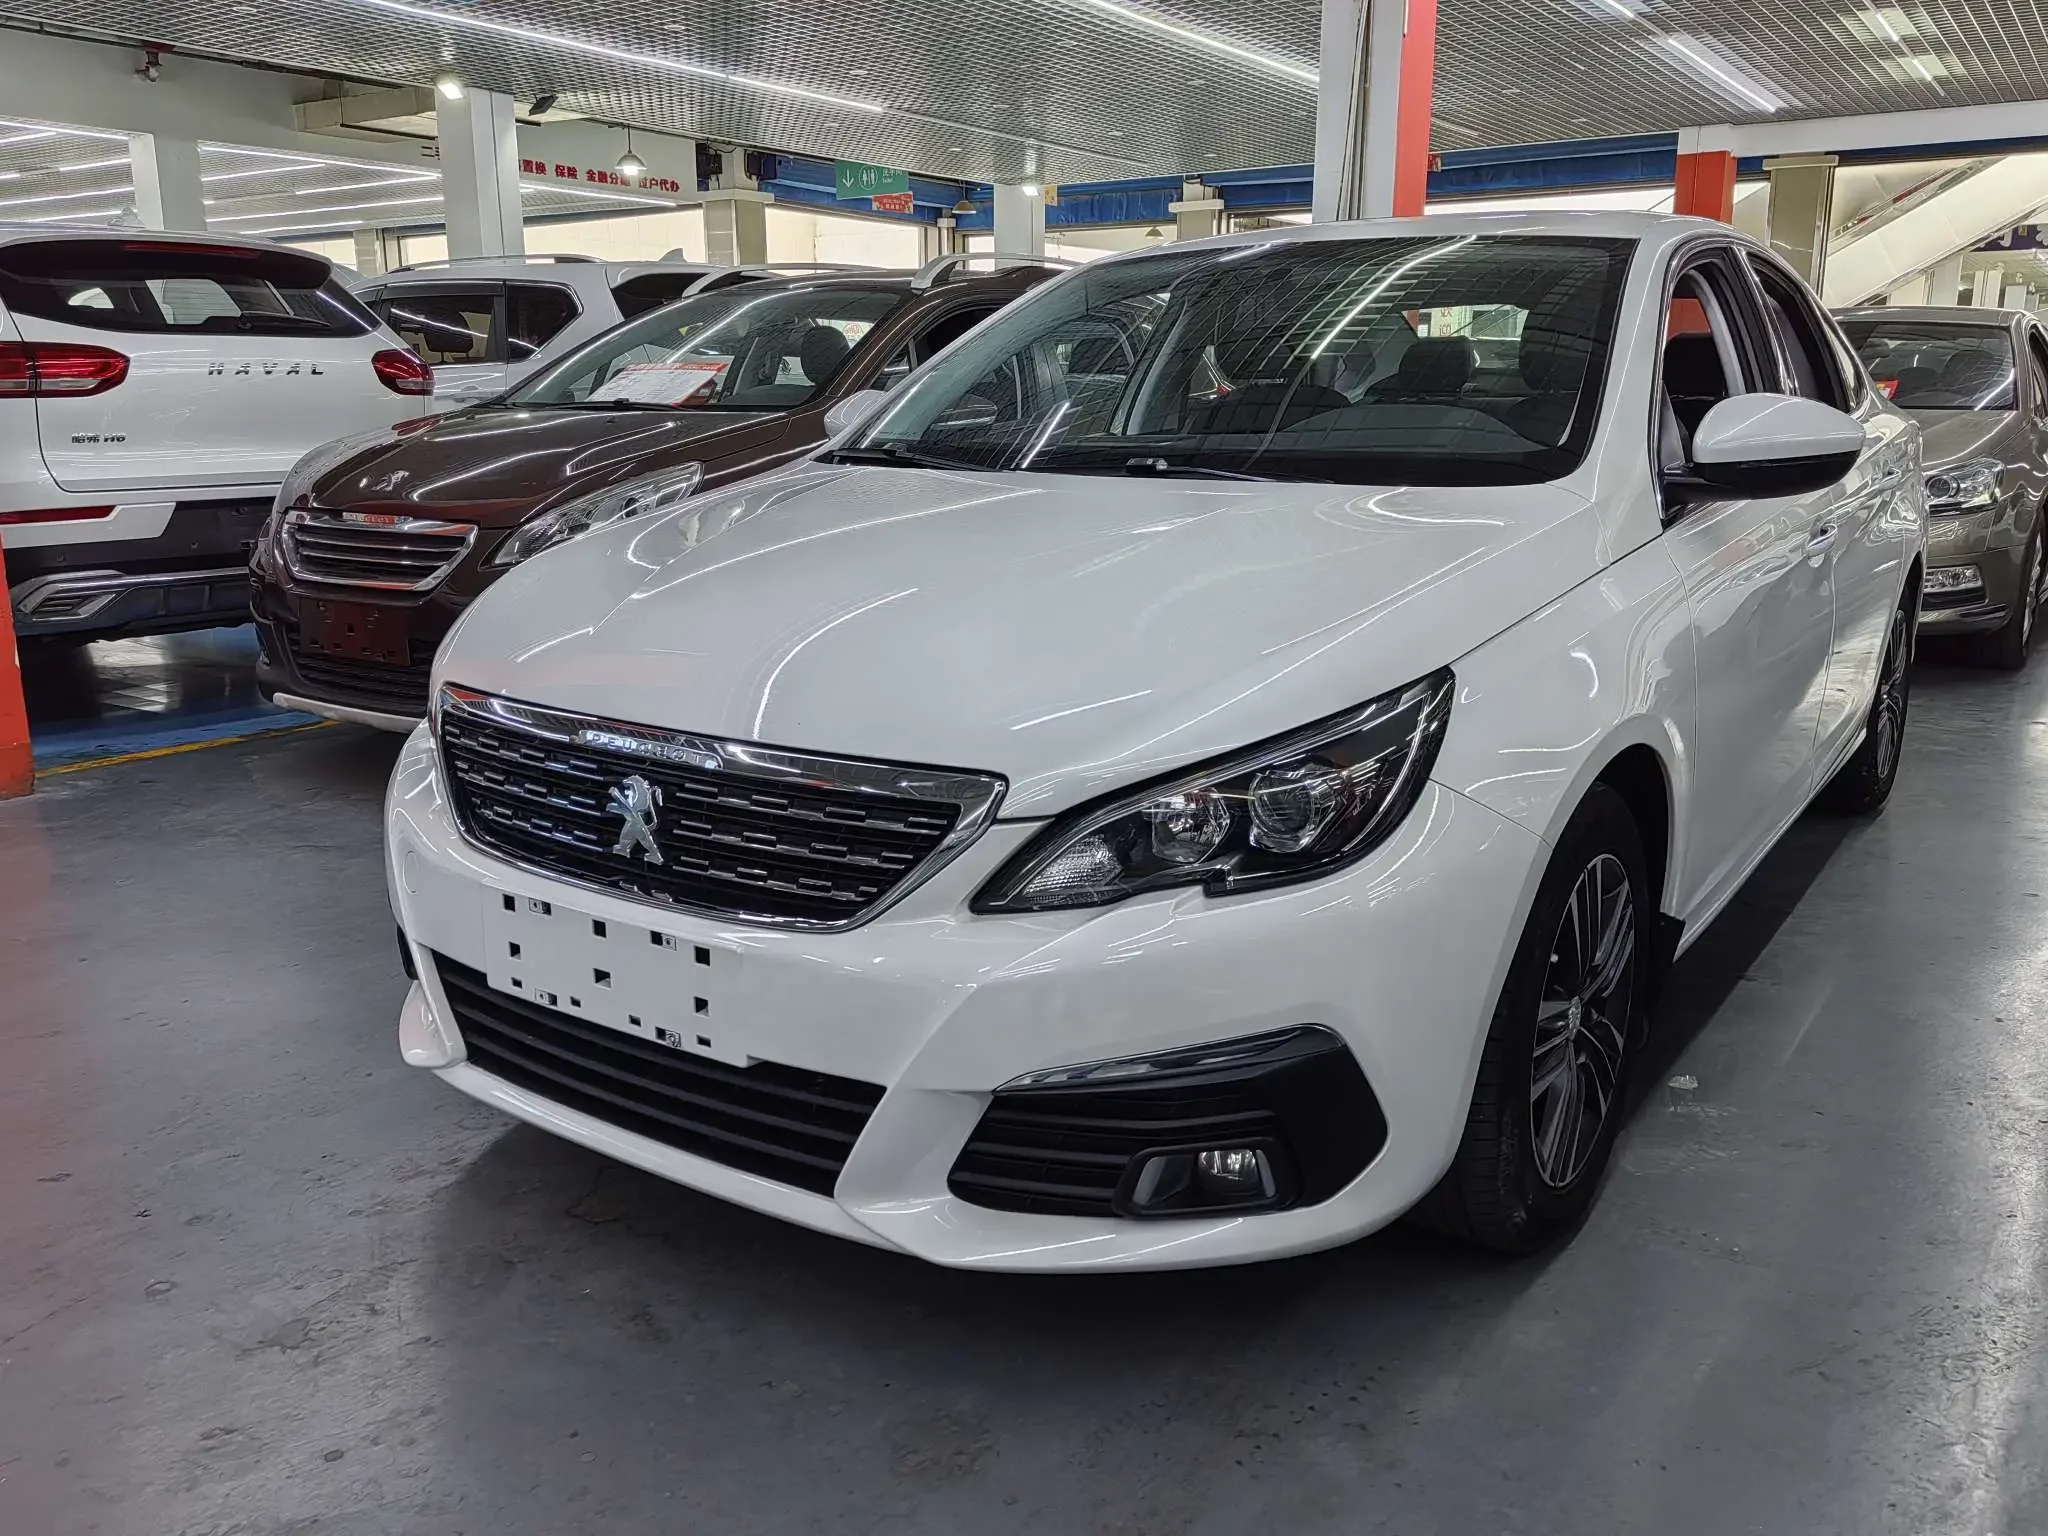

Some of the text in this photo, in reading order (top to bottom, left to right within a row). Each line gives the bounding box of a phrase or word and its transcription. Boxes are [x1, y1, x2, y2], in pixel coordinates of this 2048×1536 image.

[518, 159, 547, 176] 置换
[555, 164, 578, 180] 保险
[208, 362, 324, 376] HAVAL
